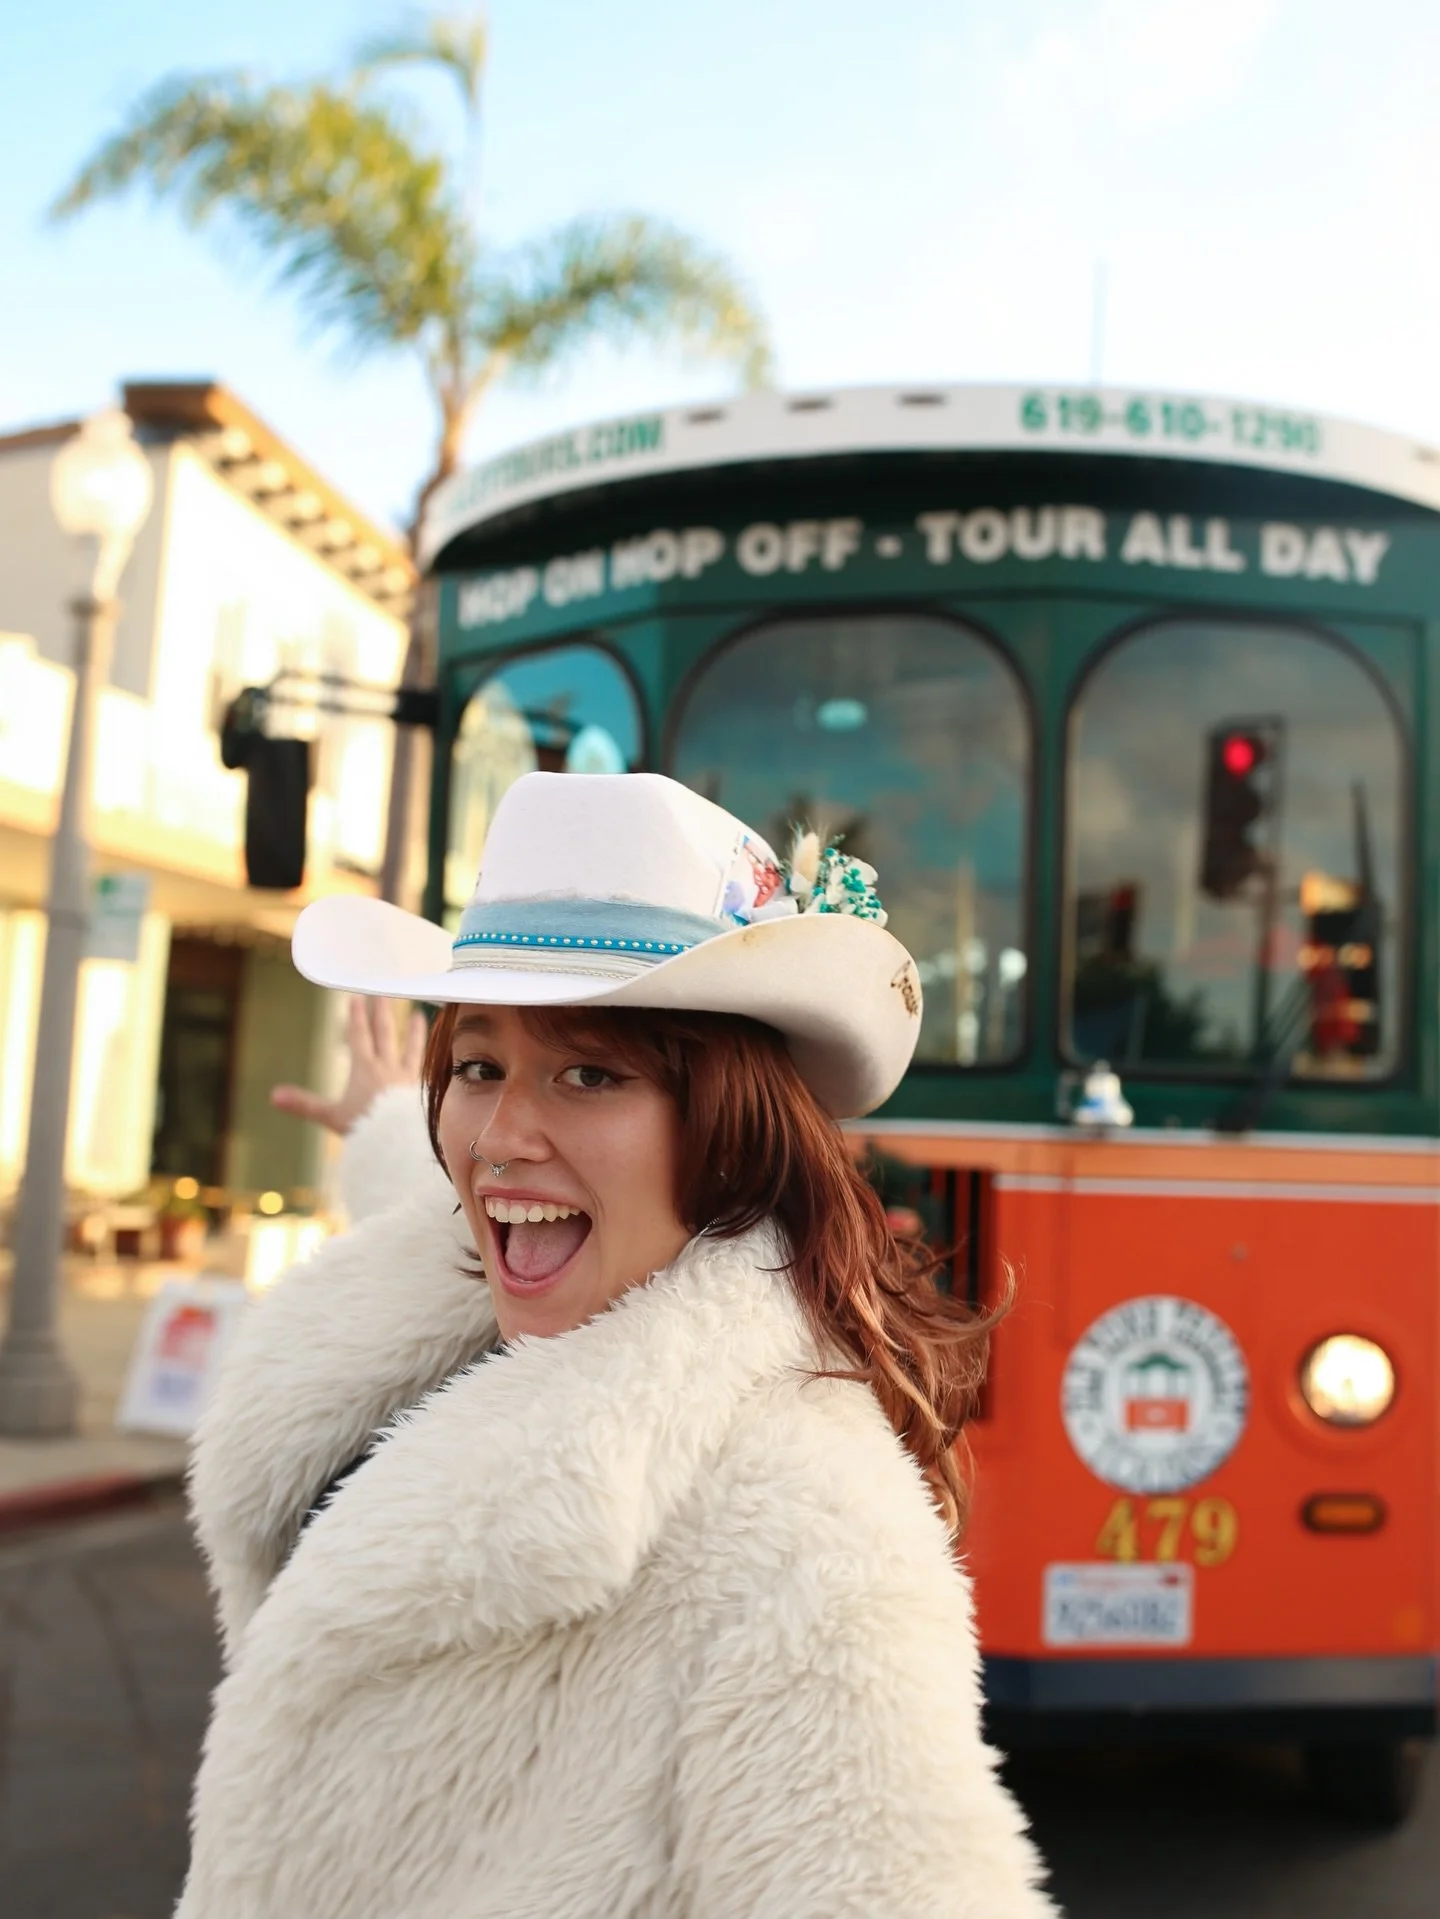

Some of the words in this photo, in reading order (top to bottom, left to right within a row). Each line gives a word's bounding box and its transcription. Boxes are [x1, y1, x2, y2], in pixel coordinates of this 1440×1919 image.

[458, 567, 538, 631] HOP
[543, 546, 605, 608] ON
[612, 528, 726, 590] HOP
[736, 517, 862, 576] OFF
[916, 504, 1106, 565] TOUR
[1120, 511, 1246, 574] ALL
[1260, 520, 1390, 586] DAY
[1094, 1497, 1238, 1567] 479
